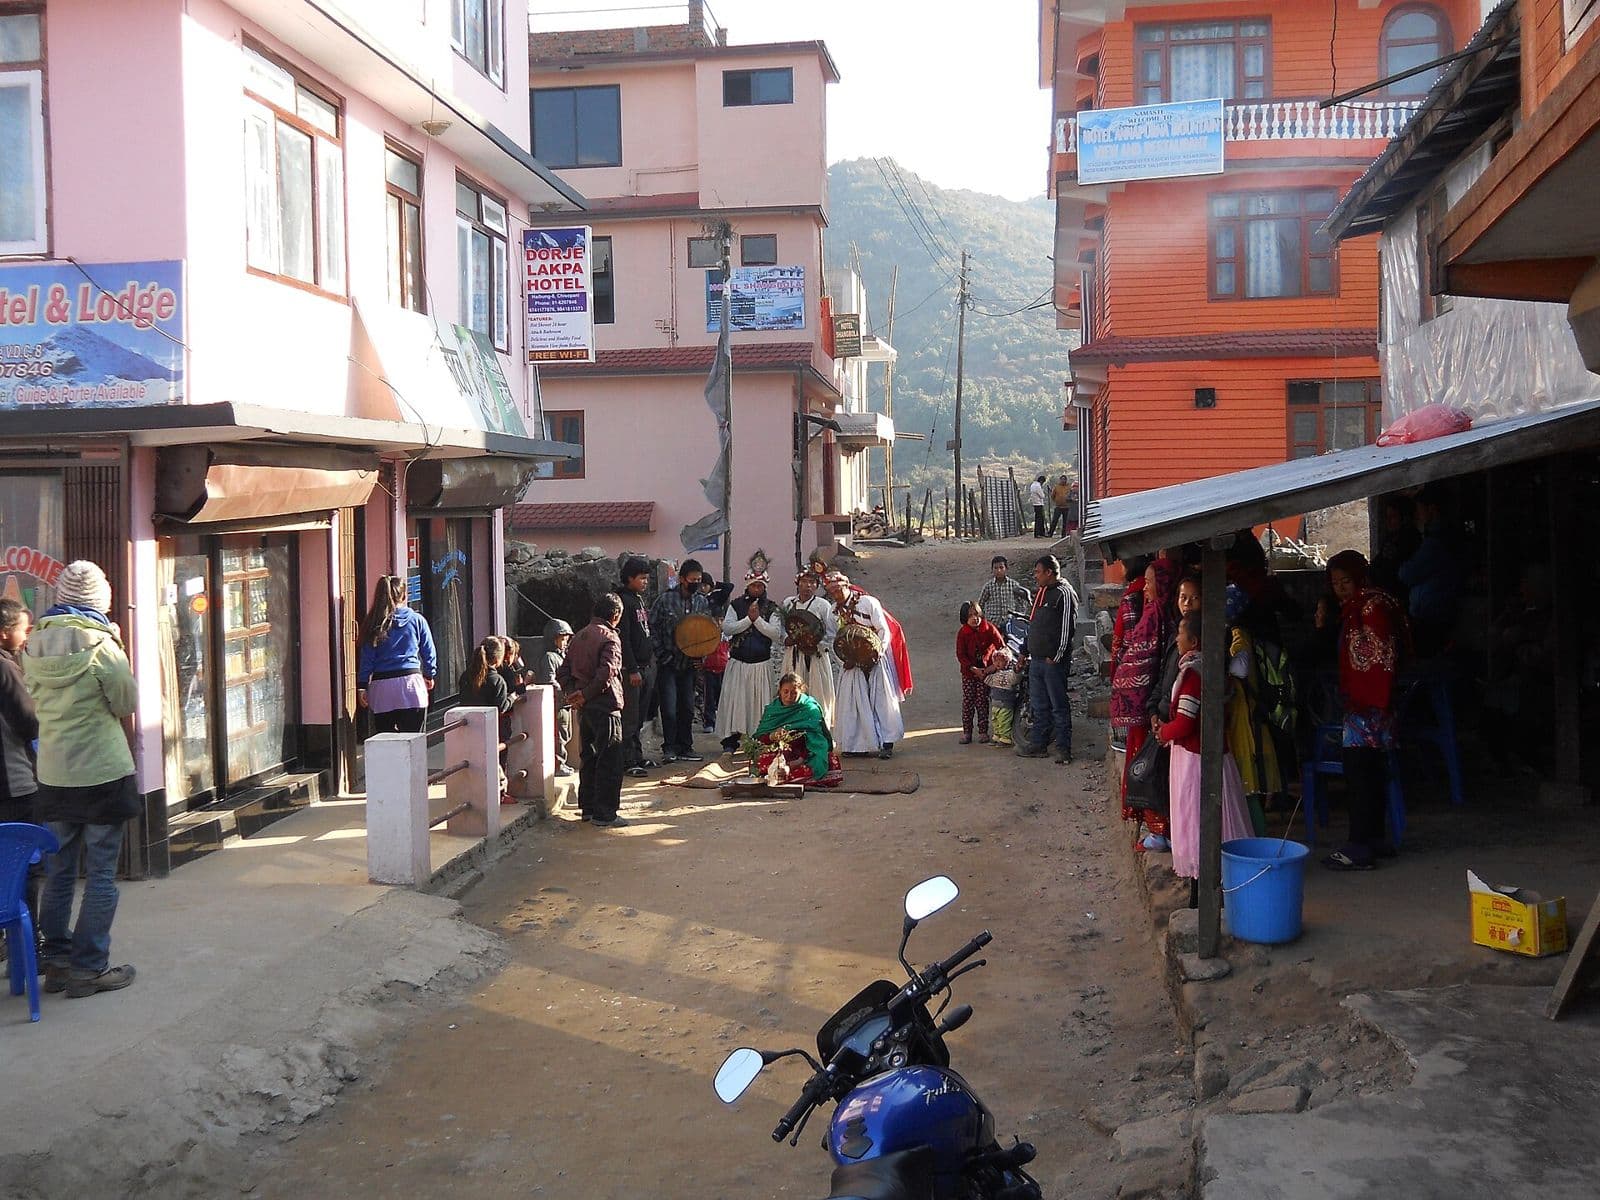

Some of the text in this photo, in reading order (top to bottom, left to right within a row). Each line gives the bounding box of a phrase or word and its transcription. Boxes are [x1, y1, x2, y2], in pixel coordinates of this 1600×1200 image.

[526, 248, 584, 261] DORJE
[527, 263, 583, 276] LAKPA
[527, 278, 585, 291] HOTEL
[709, 282, 741, 291] HOEL
[45, 285, 70, 324] &
[78, 282, 175, 330] Lodge
[529, 350, 587, 360] FREE WI-FI
[16, 386, 47, 403] Guide
[61, 385, 96, 402] Porter
[96, 383, 146, 400] Available
